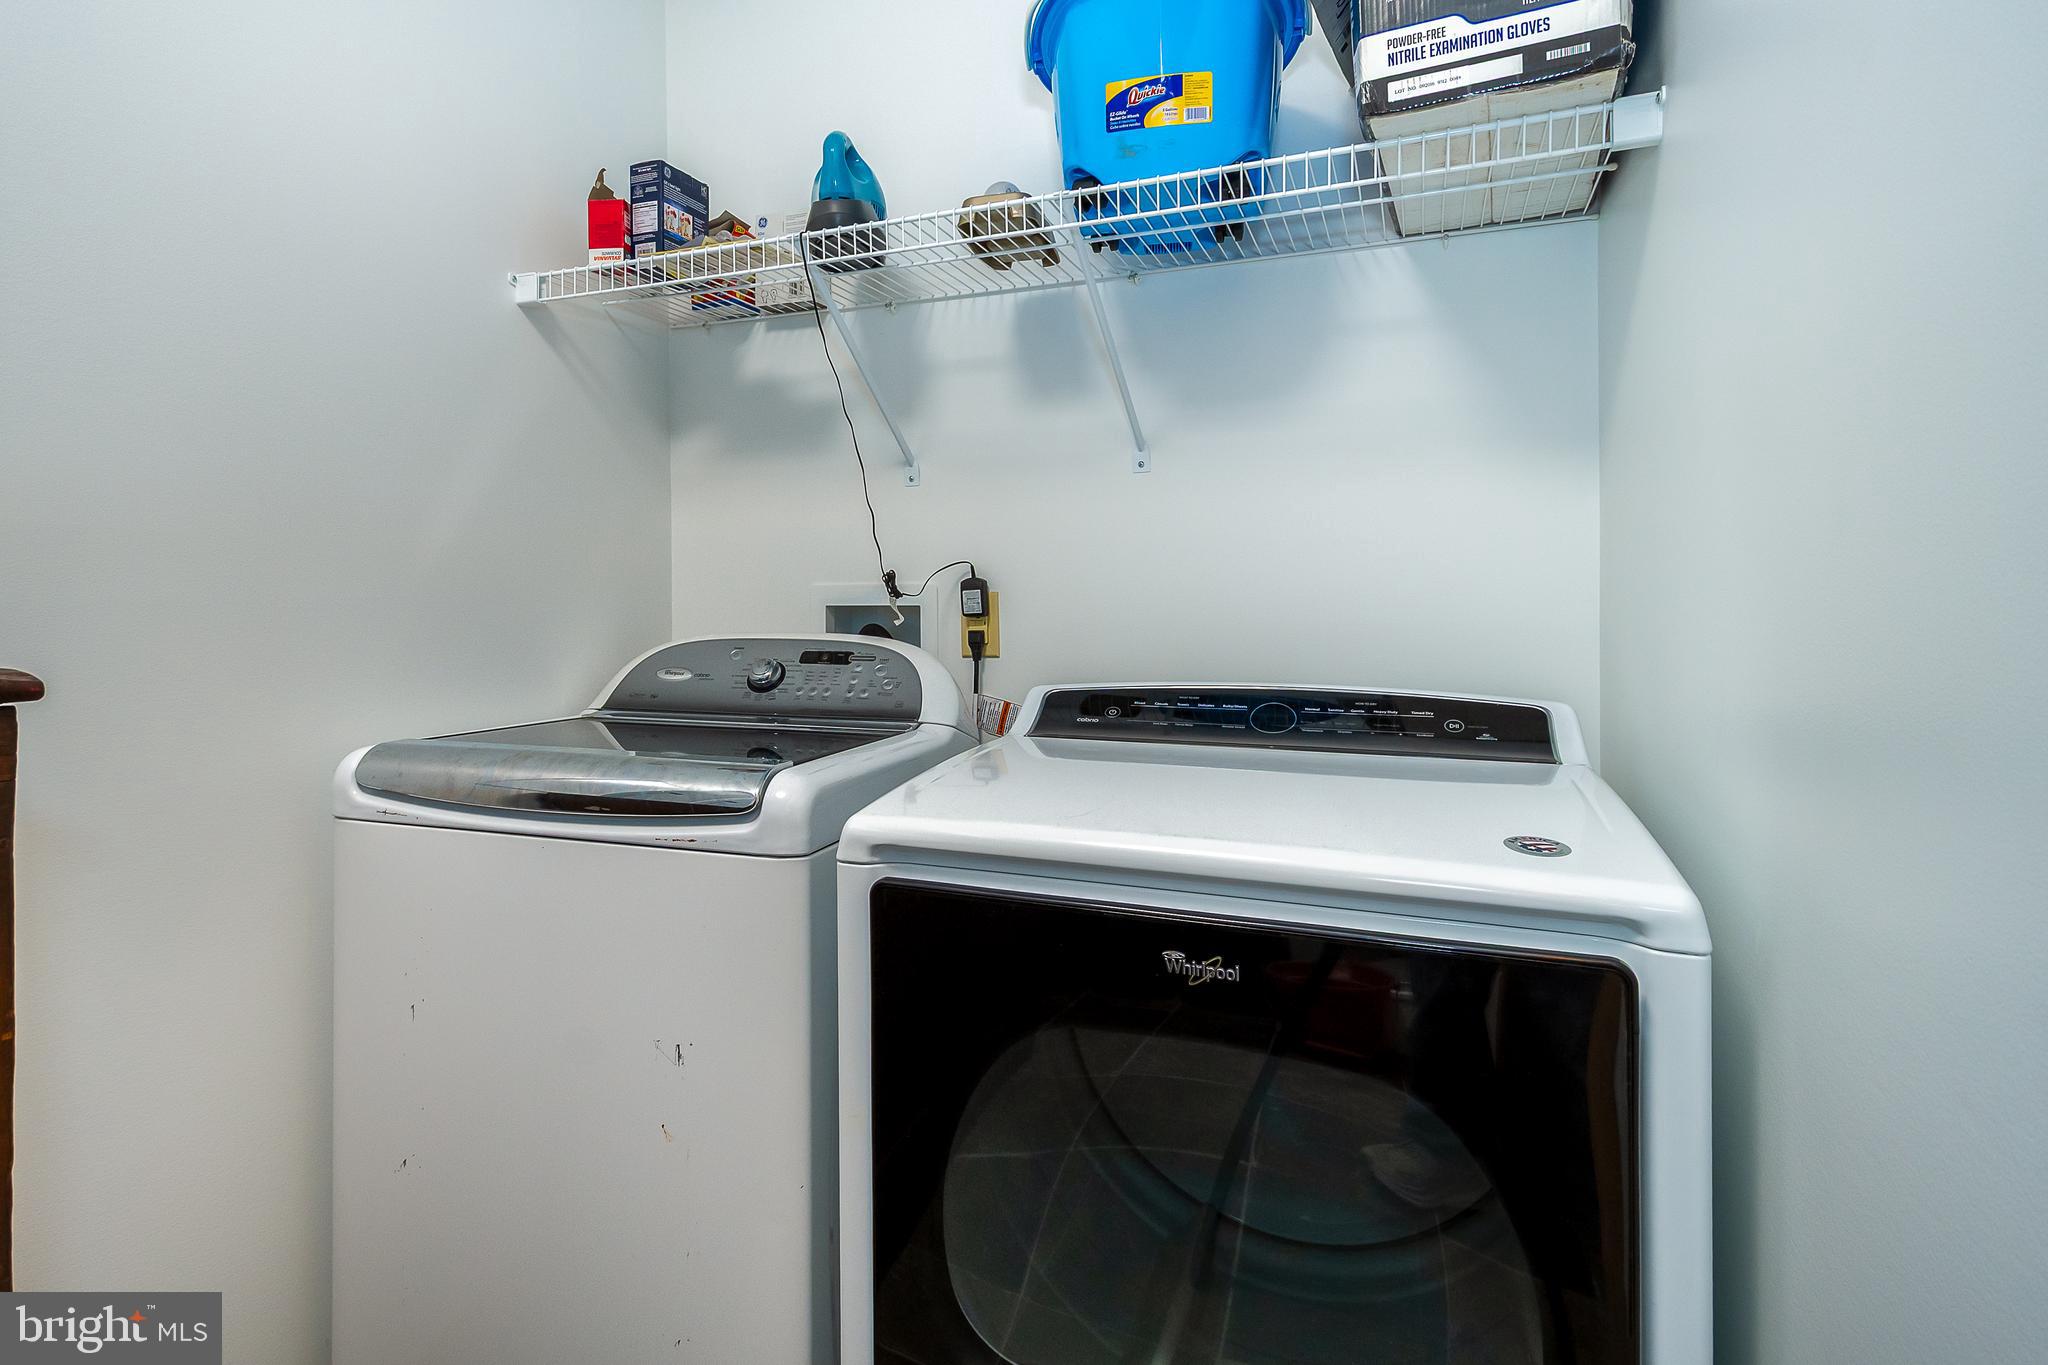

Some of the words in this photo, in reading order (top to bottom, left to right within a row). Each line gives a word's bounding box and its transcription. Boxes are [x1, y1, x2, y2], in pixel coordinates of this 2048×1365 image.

[1387, 26, 1447, 50] POWDER-FREE
[1387, 45, 1428, 67] NITRILE
[1429, 27, 1504, 58] EXAMINATION
[1507, 17, 1551, 41] GLOVES
[1128, 84, 1166, 106] Quickie
[1162, 951, 1240, 985] Whirlpool
